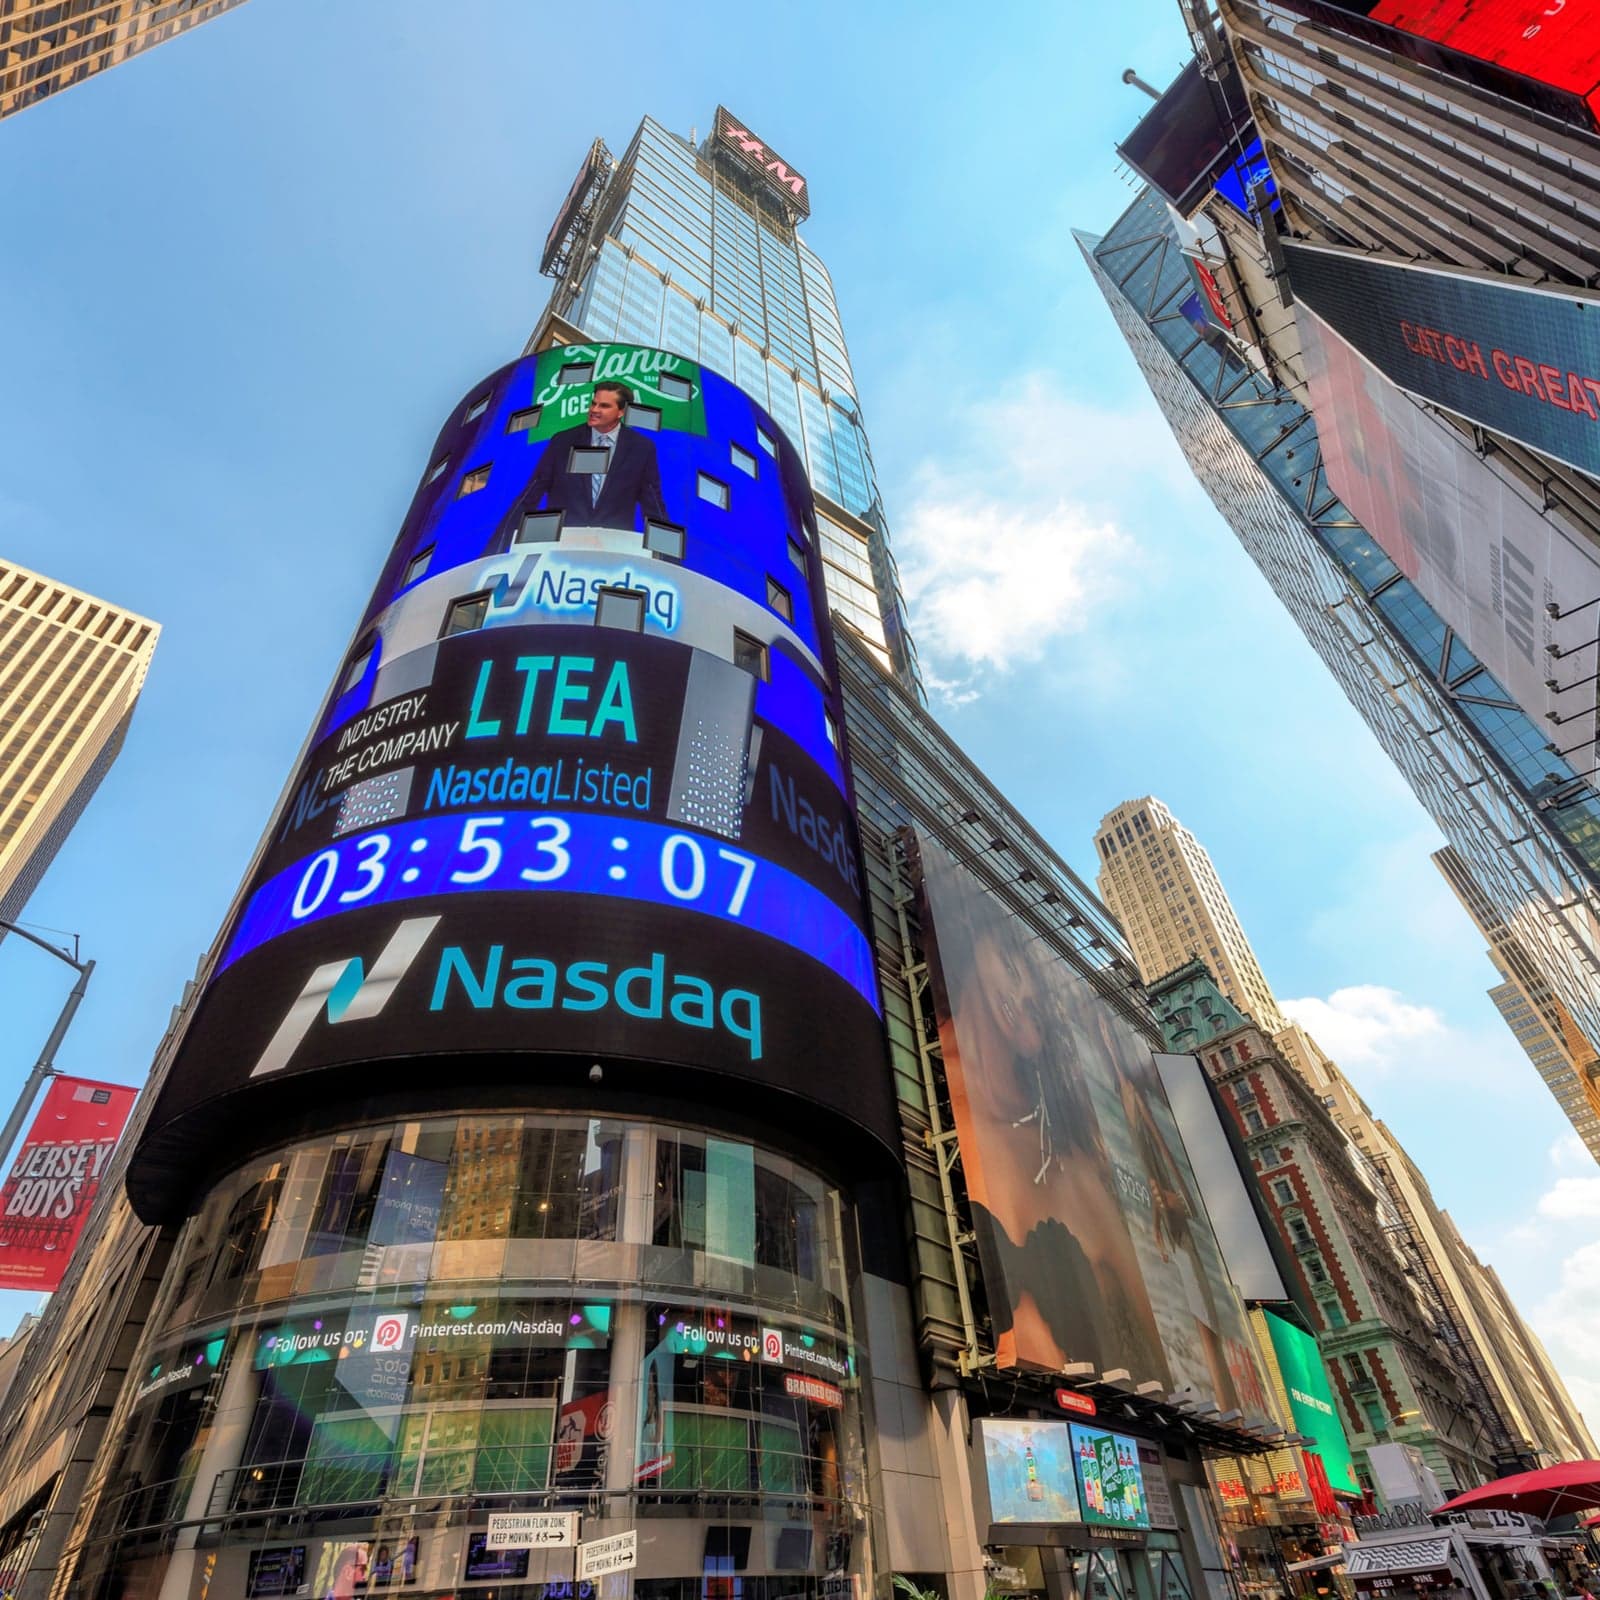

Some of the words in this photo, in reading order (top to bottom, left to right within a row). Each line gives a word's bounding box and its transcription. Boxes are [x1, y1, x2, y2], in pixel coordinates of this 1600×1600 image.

[1400, 319, 1489, 381] CATCH
[1502, 535, 1535, 668] ANTI
[464, 655, 639, 744] LTEA
[336, 693, 428, 753] INDUSTRY.
[323, 752, 359, 792] THE
[357, 721, 460, 773] COMPANY
[428, 945, 763, 1060] Nasdaq
[11, 1143, 115, 1178] JERSEY
[5, 1178, 82, 1219] BOYS
[273, 1334, 321, 1354] Follow
[324, 1331, 342, 1347] us
[409, 1320, 564, 1338] Pinterest.com/Nasdaq
[683, 1325, 725, 1344] Follow
[728, 1333, 742, 1347] us
[491, 1532, 508, 1544] KEEP
[508, 1531, 534, 1543] MOVING
[492, 1518, 532, 1529] PEDESTRIAN
[531, 1517, 550, 1528] FLOW
[550, 1516, 566, 1528] ZONE
[1373, 1578, 1394, 1588] BEER
[1412, 1573, 1434, 1584] WINE
